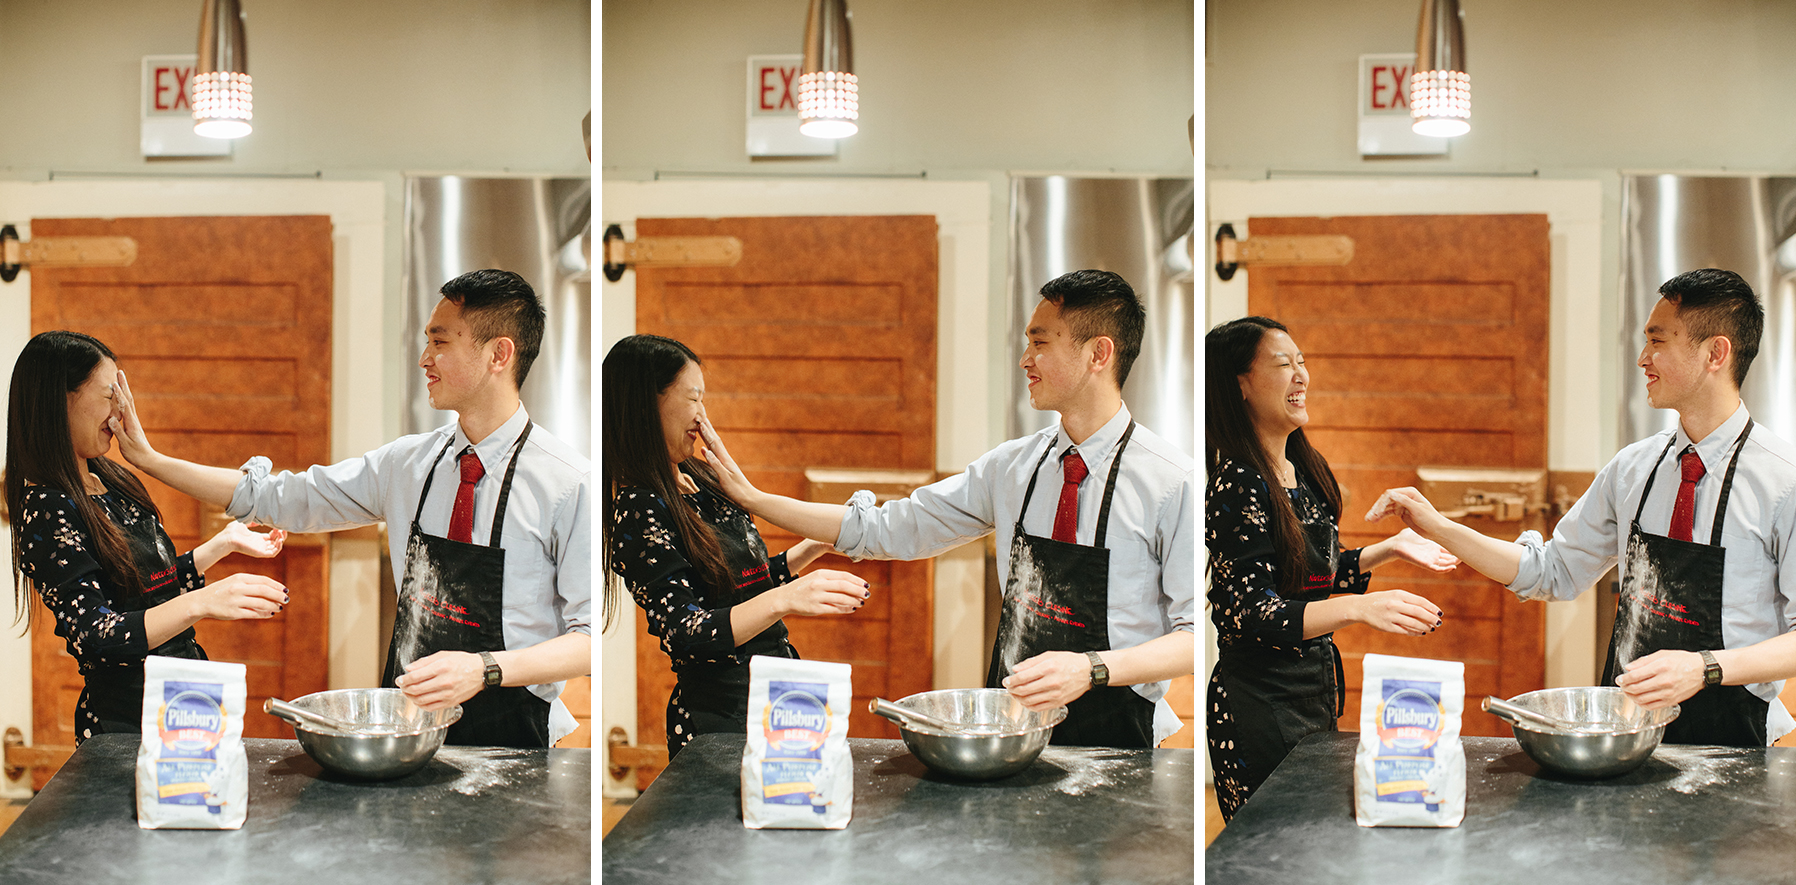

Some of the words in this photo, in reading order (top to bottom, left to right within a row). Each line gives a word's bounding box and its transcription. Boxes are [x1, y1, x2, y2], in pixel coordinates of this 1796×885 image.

[154, 67, 197, 110] EX
[760, 67, 802, 110] EX
[1372, 66, 1415, 109] EX
[167, 708, 219, 731] Pillsbury
[772, 708, 824, 731] Pillsbury
[1385, 706, 1437, 729] Pillsbury
[178, 729, 206, 740] BEST
[783, 729, 811, 740] BEST
[1396, 727, 1424, 738] BEST
